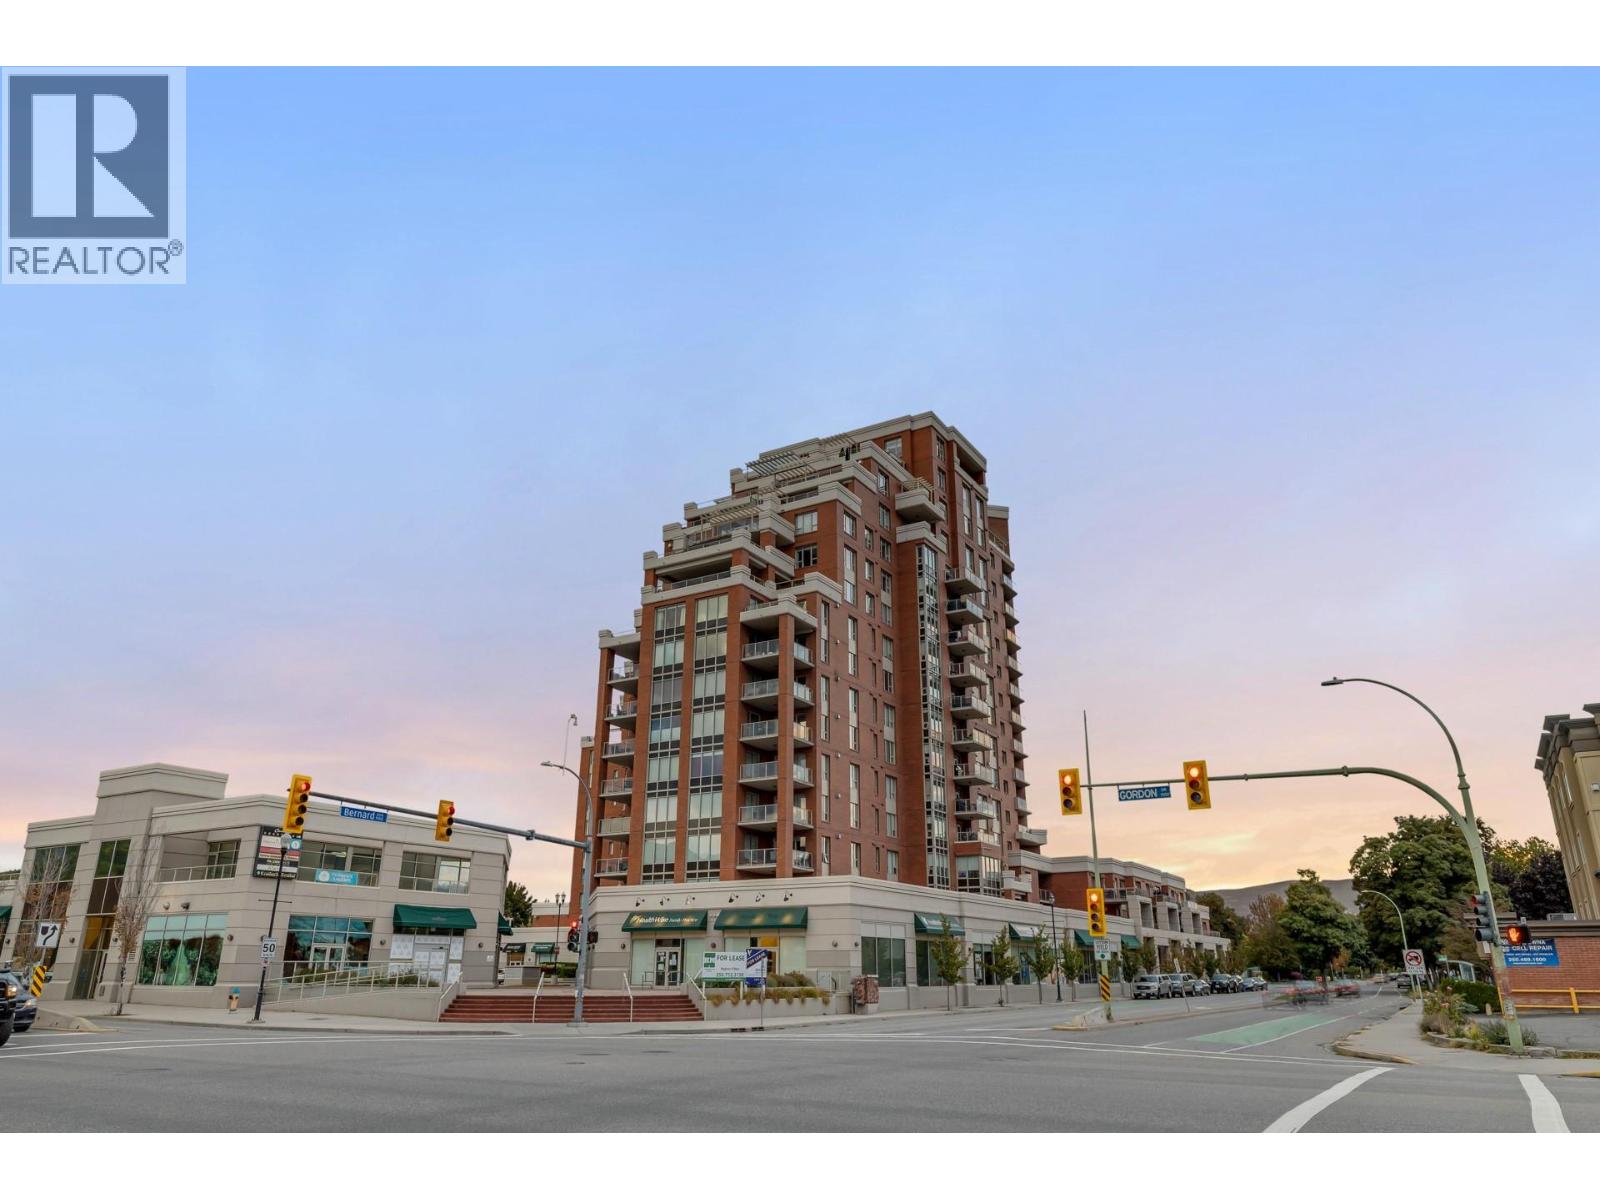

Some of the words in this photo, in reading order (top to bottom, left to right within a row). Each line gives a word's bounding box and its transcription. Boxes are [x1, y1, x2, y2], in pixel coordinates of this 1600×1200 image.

[1120, 788, 1157, 800] GORDON
[344, 808, 375, 820] Bernard
[262, 943, 275, 953] 50
